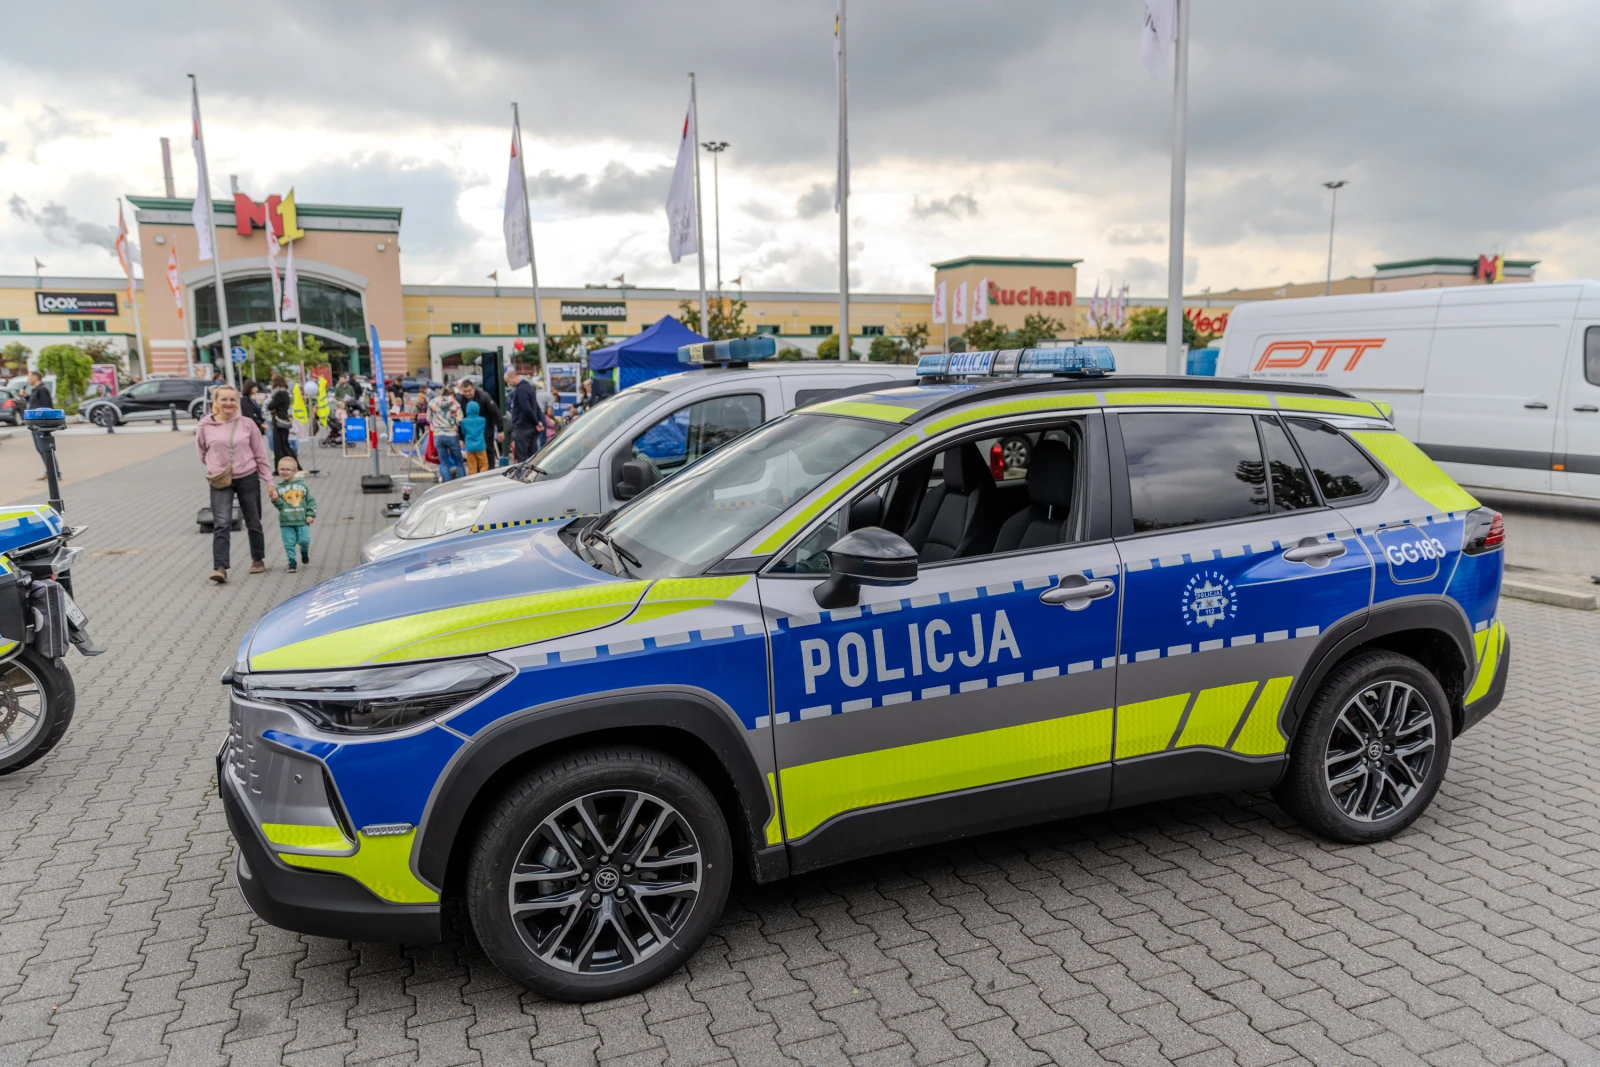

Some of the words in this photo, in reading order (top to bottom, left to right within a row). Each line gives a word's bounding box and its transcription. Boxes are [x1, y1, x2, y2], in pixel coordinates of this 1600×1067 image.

[234, 187, 305, 246] M1
[950, 351, 990, 372] POLICJA
[1253, 338, 1387, 372] PTT
[1386, 538, 1447, 566] GG183
[1197, 590, 1221, 599] POLICJA
[800, 609, 1022, 695] POLICJA
